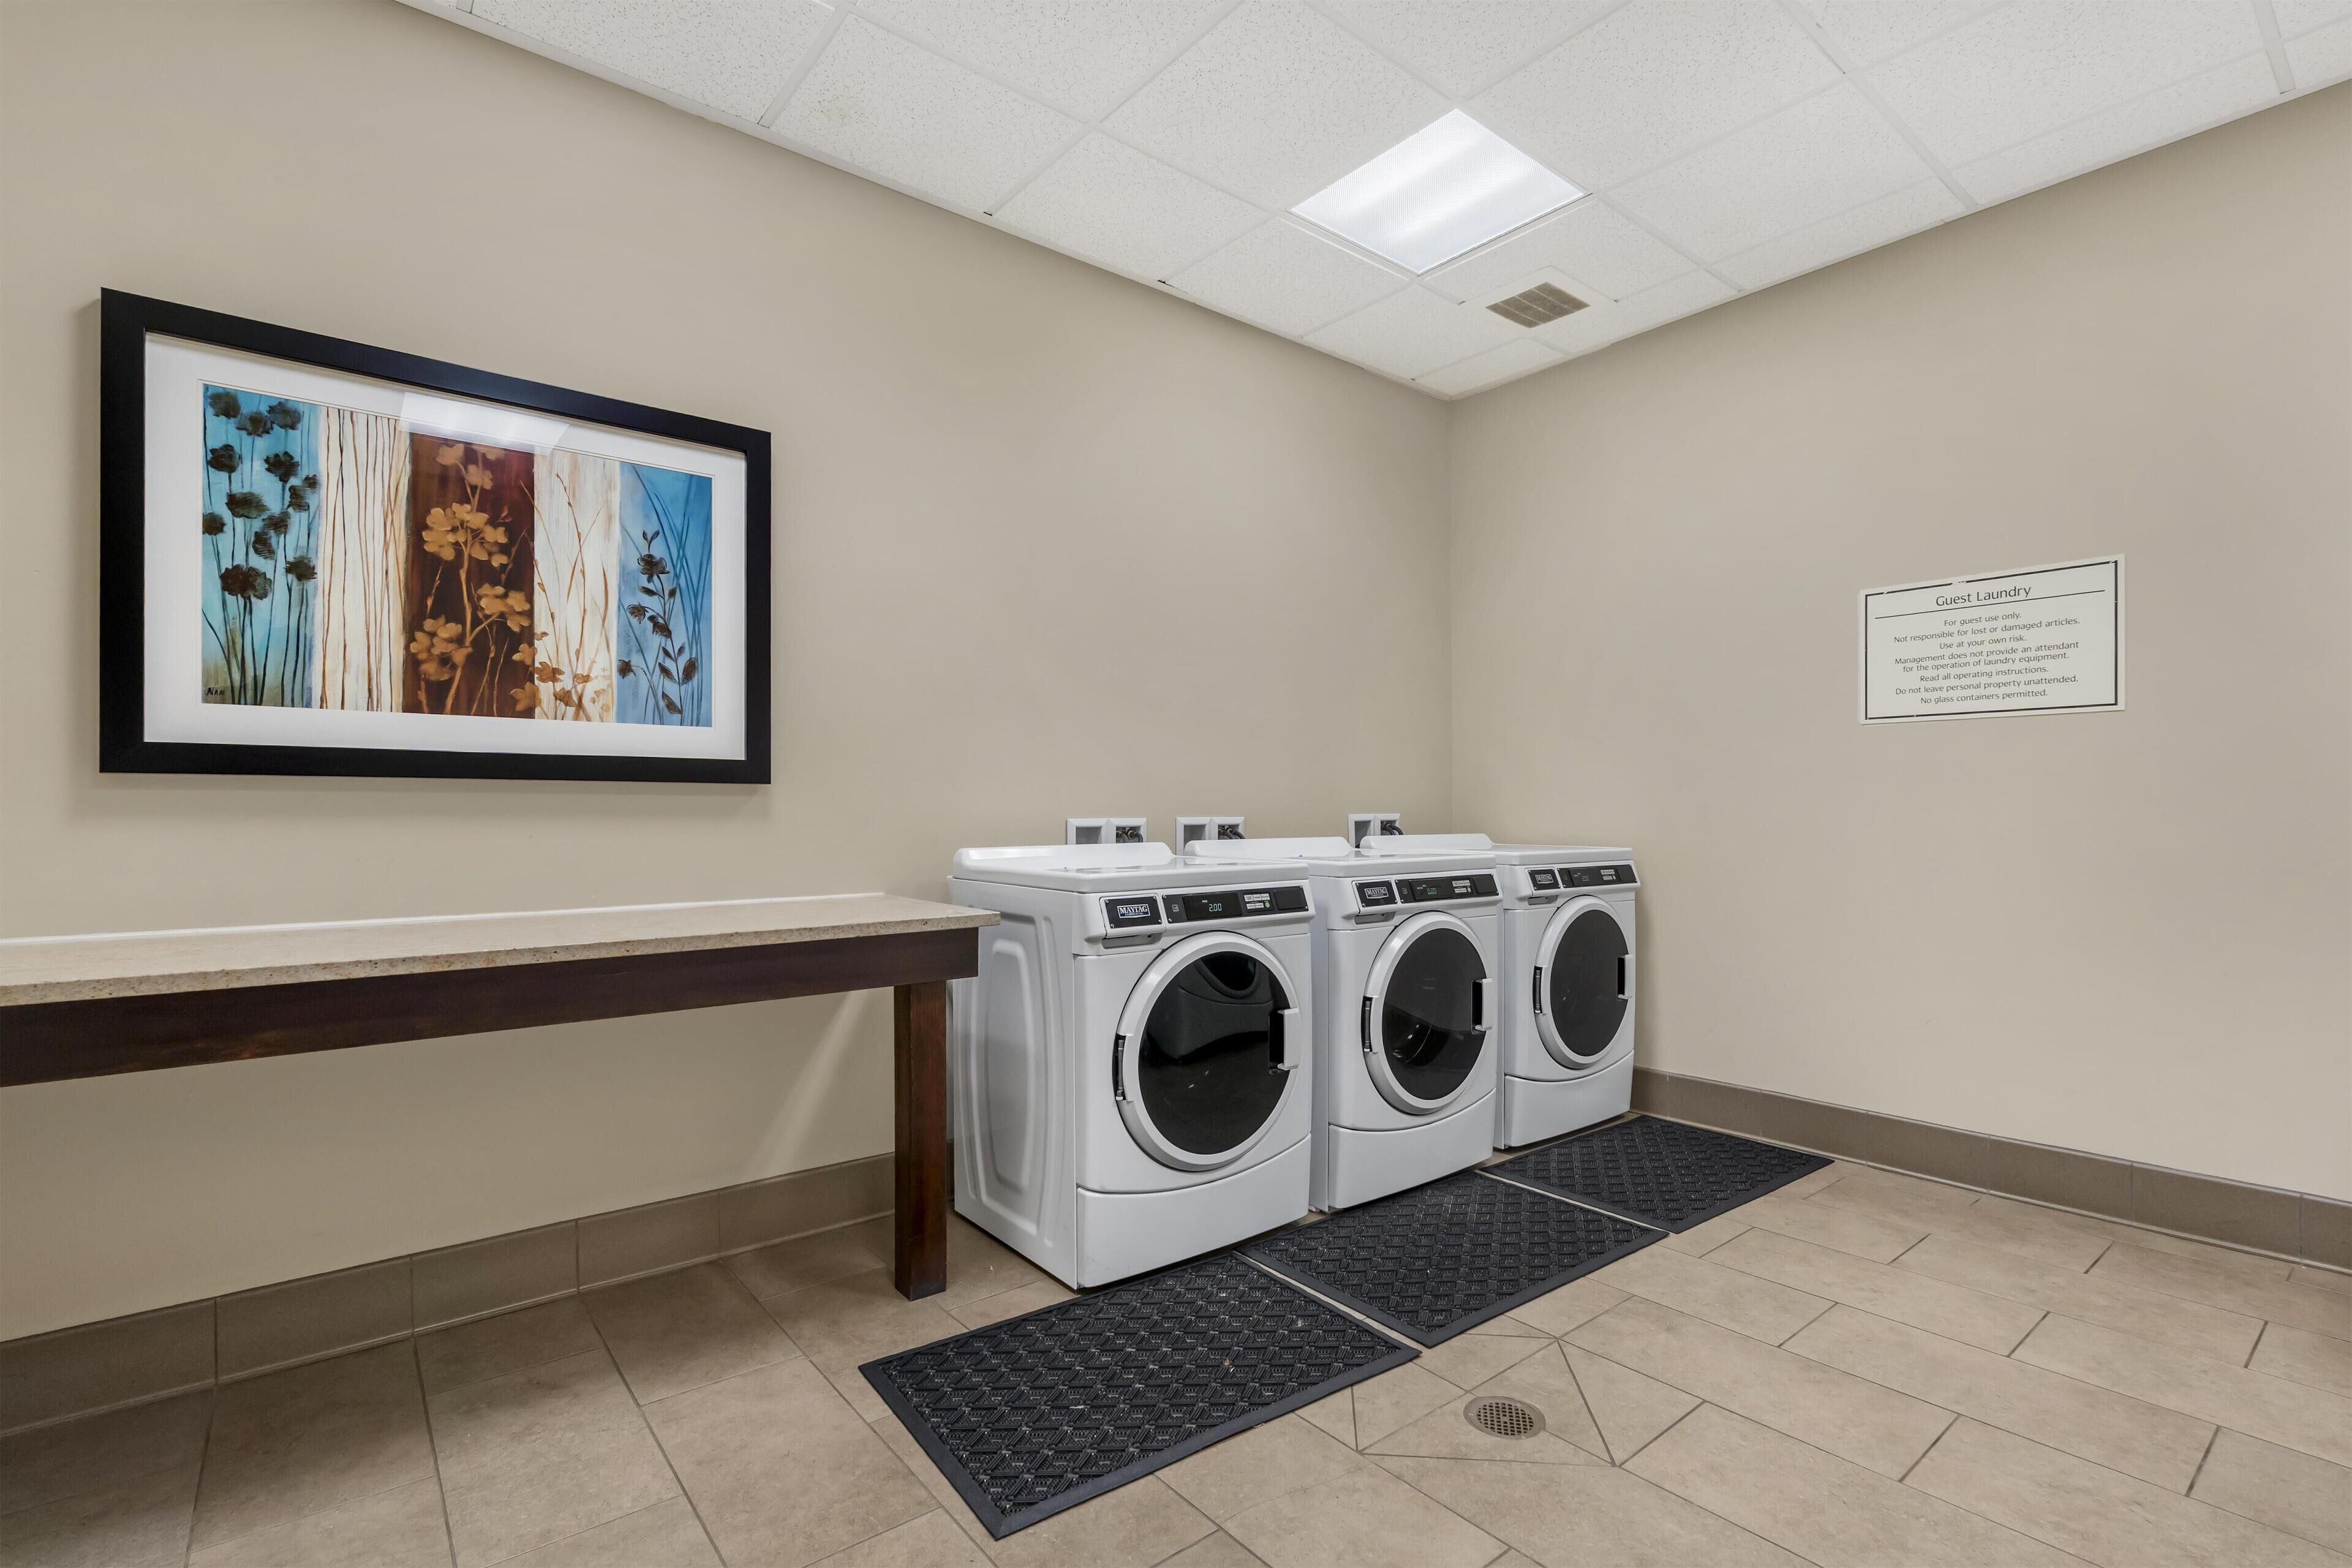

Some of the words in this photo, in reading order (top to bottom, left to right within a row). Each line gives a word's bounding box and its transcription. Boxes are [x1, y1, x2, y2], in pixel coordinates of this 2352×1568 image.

[1936, 593, 1972, 606] Guest
[1977, 586, 2032, 601] Laundry
[1910, 631, 1954, 641] responsible
[2001, 620, 2042, 631] damaged
[2045, 617, 2080, 627] articles.
[1959, 617, 1982, 626] guest
[1895, 654, 1945, 664] Management
[1986, 647, 2018, 658] provide
[2035, 642, 2079, 652] attendant
[1931, 661, 1970, 671] operation
[1984, 657, 2016, 665] laundry
[2019, 652, 2069, 663] equipment.
[1953, 670, 1992, 680] operating
[1996, 666, 2048, 676] instructions.
[1947, 682, 1981, 692] personal
[1984, 680, 2021, 690] property
[2024, 674, 2078, 685] unattended.
[1934, 696, 1954, 704] glass
[2002, 688, 2048, 700] permitted.
[1208, 903, 1222, 911] 2.00
